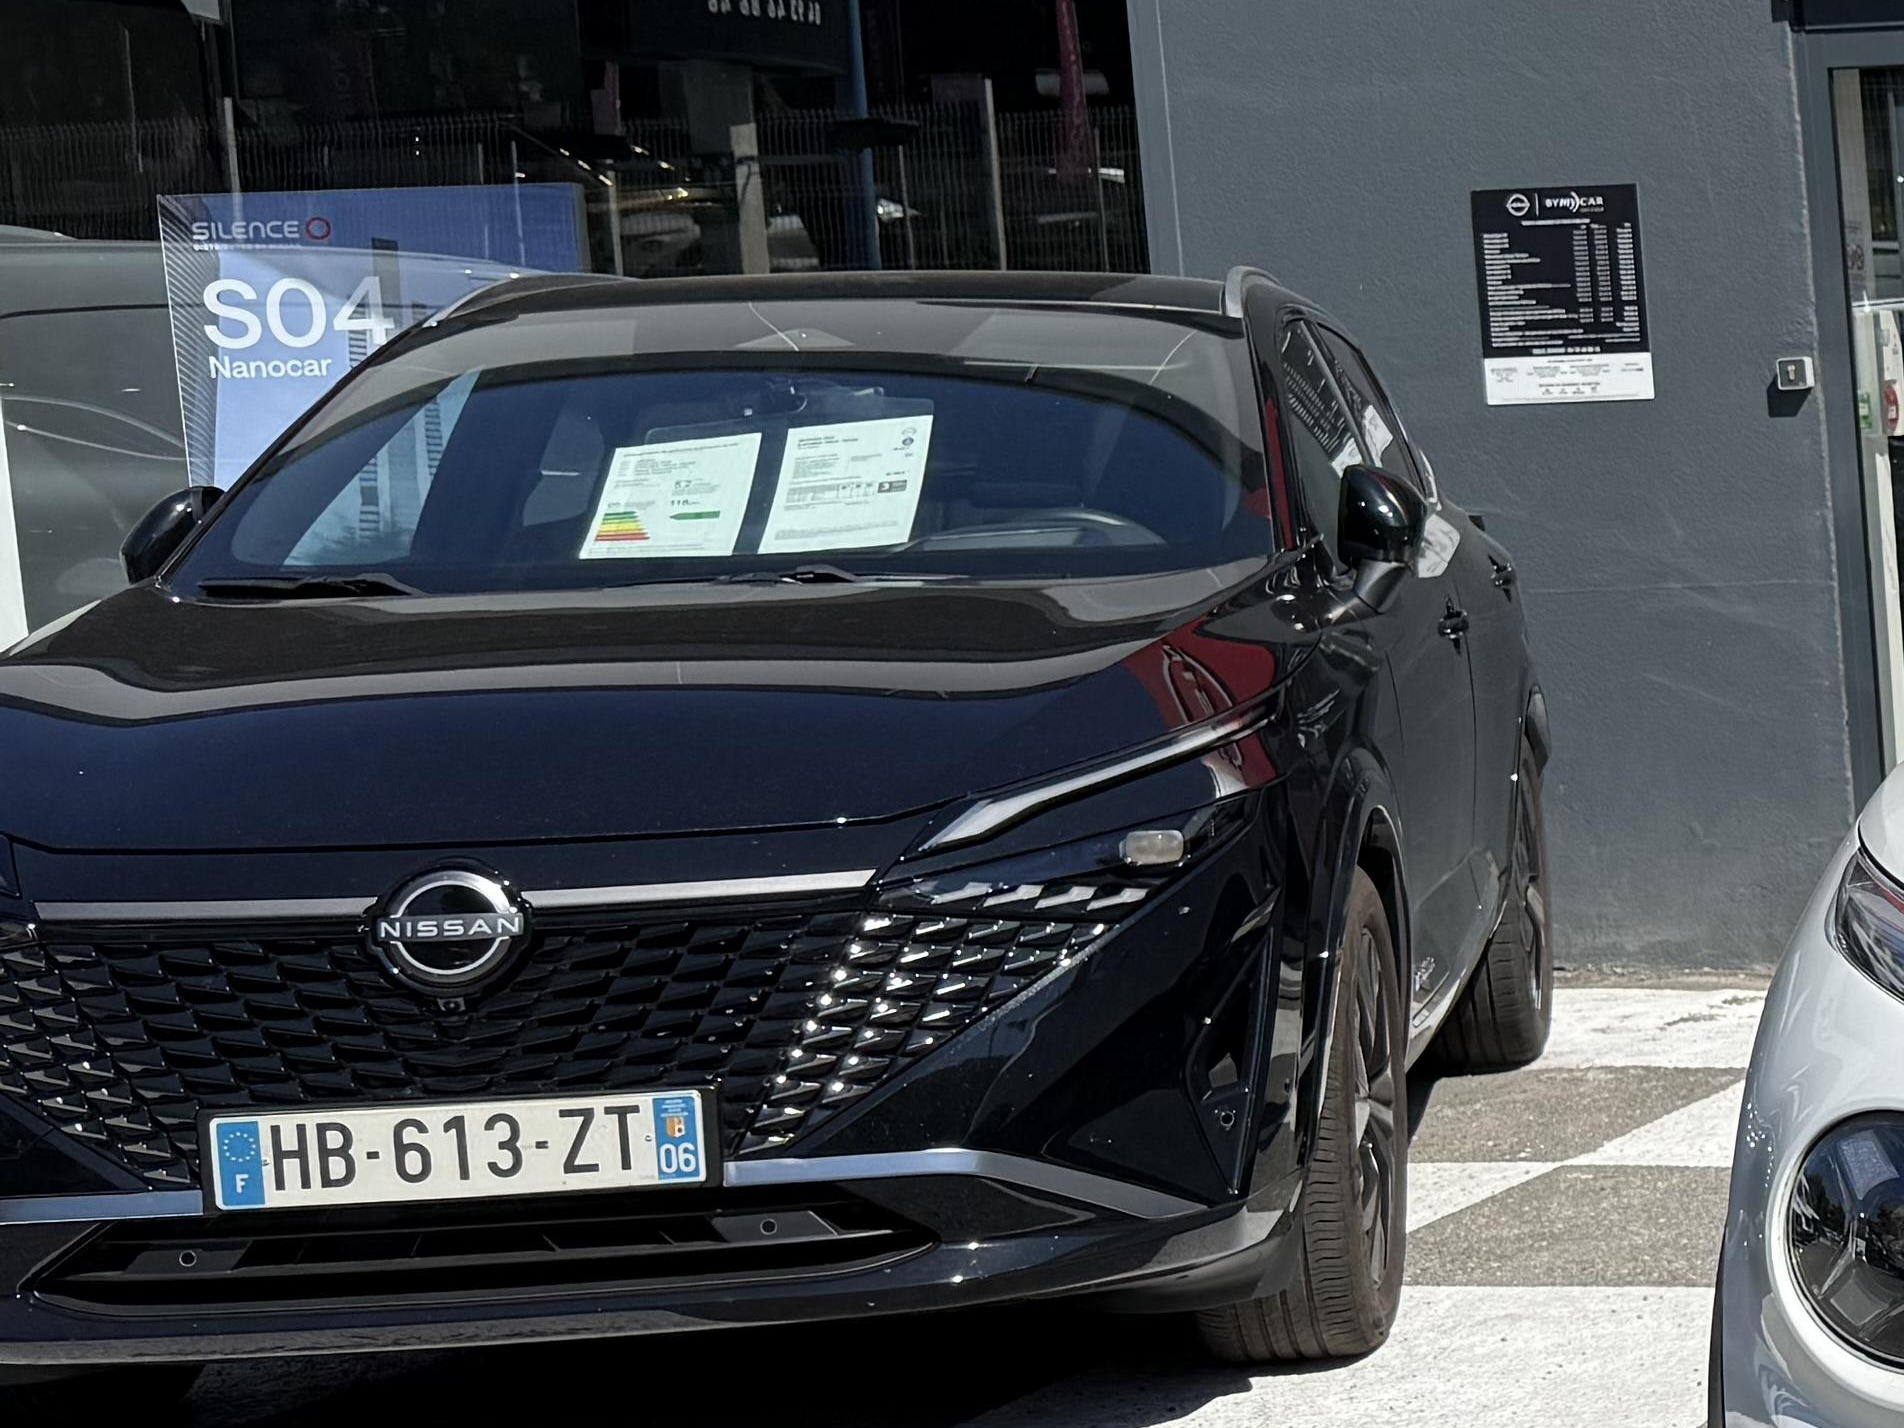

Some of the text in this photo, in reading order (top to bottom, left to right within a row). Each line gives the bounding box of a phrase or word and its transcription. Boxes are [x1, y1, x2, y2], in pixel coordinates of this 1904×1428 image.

[192, 220, 300, 240] SILENCE
[208, 355, 332, 380] Nanocar
[379, 916, 520, 939] NISSAN
[269, 1104, 642, 1192] HB-613-ZT
[659, 1141, 697, 1175] 06
[236, 1173, 250, 1194] F
